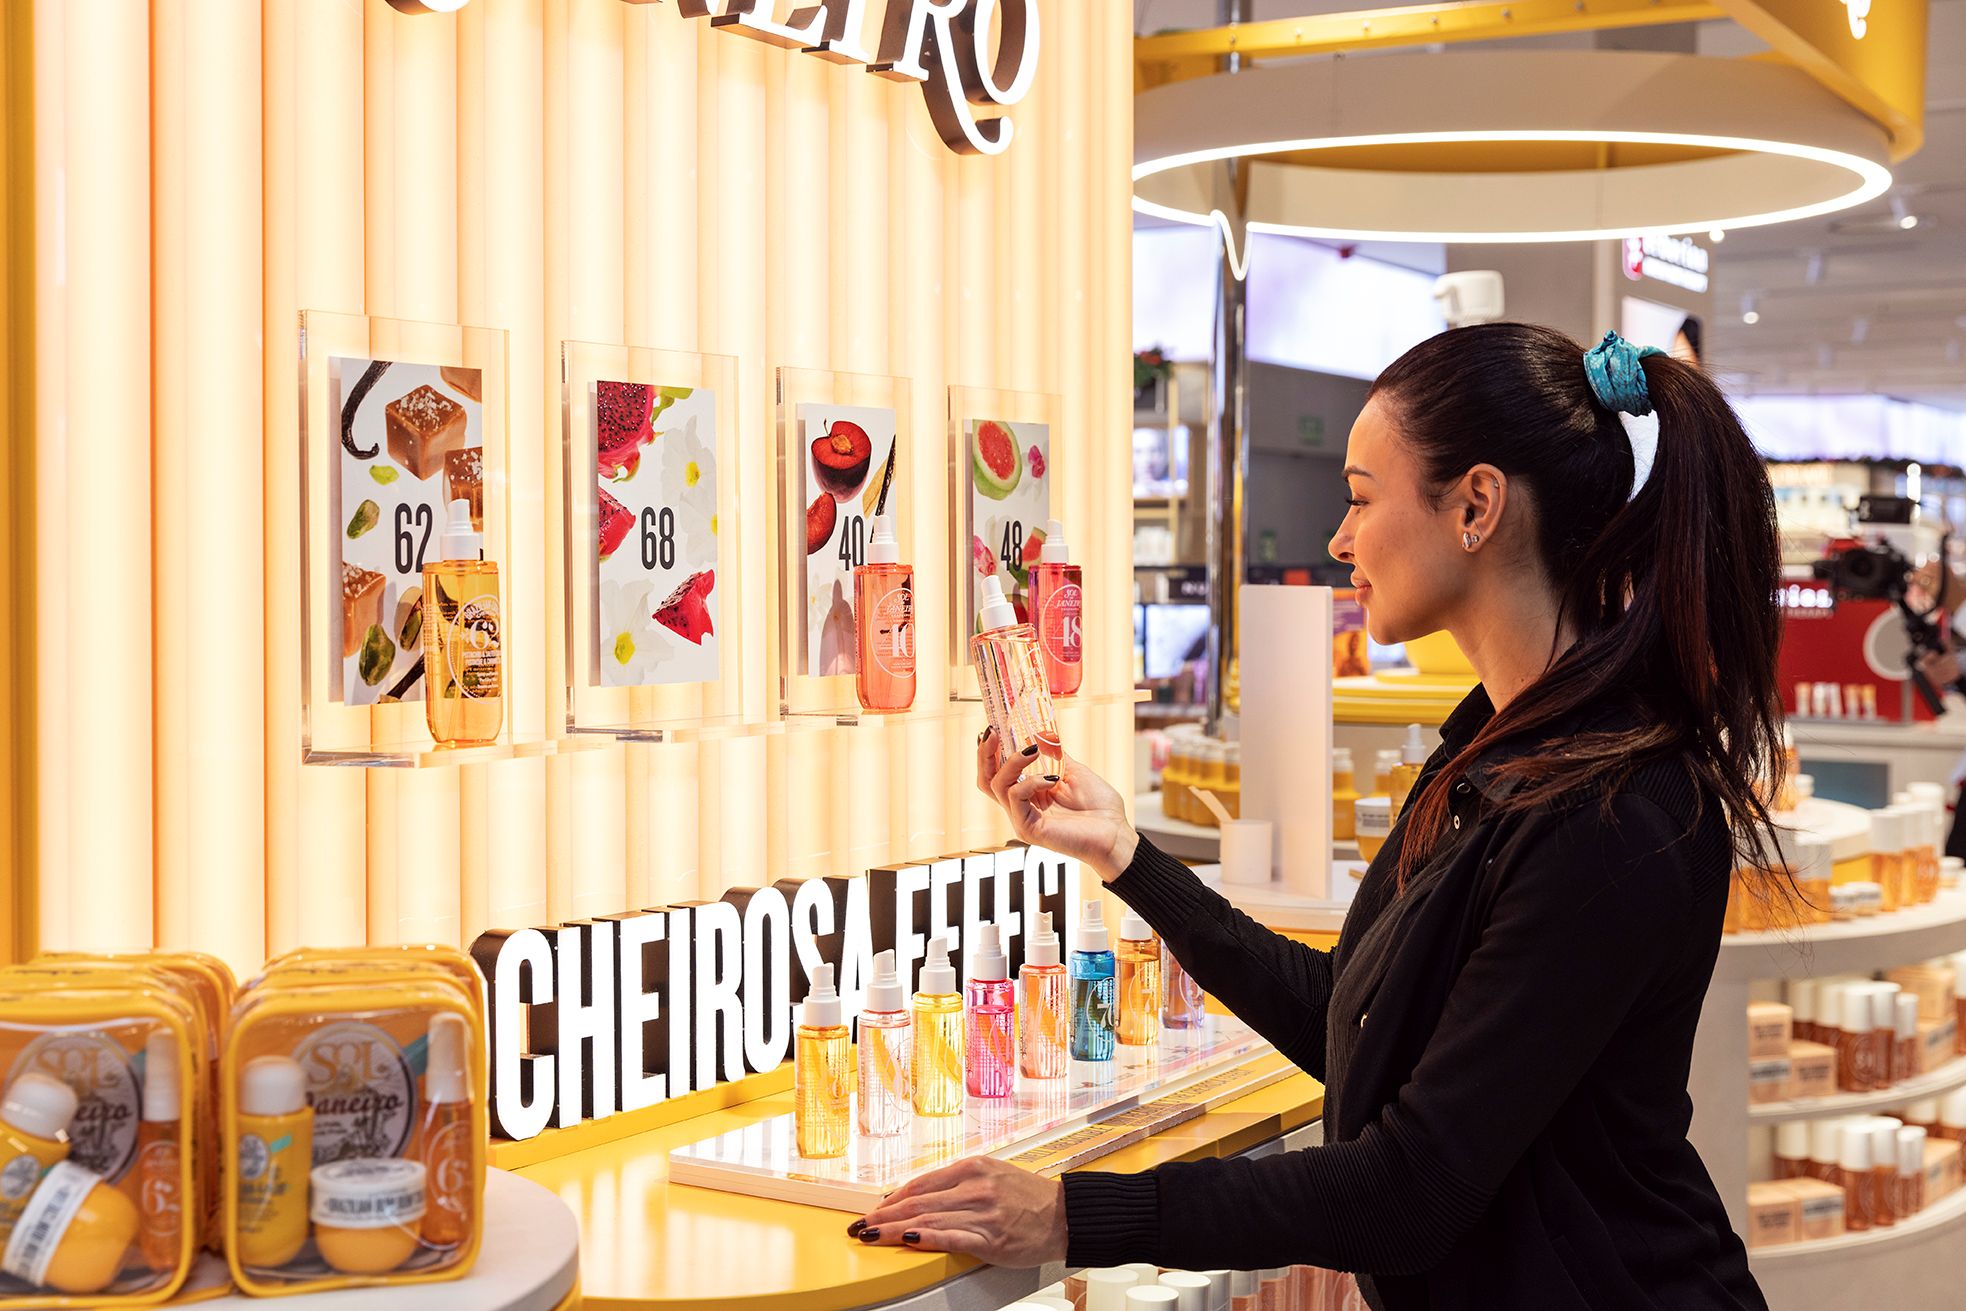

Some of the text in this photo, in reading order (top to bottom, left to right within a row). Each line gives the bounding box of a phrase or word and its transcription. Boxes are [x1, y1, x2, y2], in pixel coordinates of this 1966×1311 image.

[394, 503, 433, 574] 62
[641, 506, 675, 570] 68
[838, 516, 864, 571] 40
[1000, 519, 1023, 572] 48
[493, 876, 878, 1141] CHEIROSA
